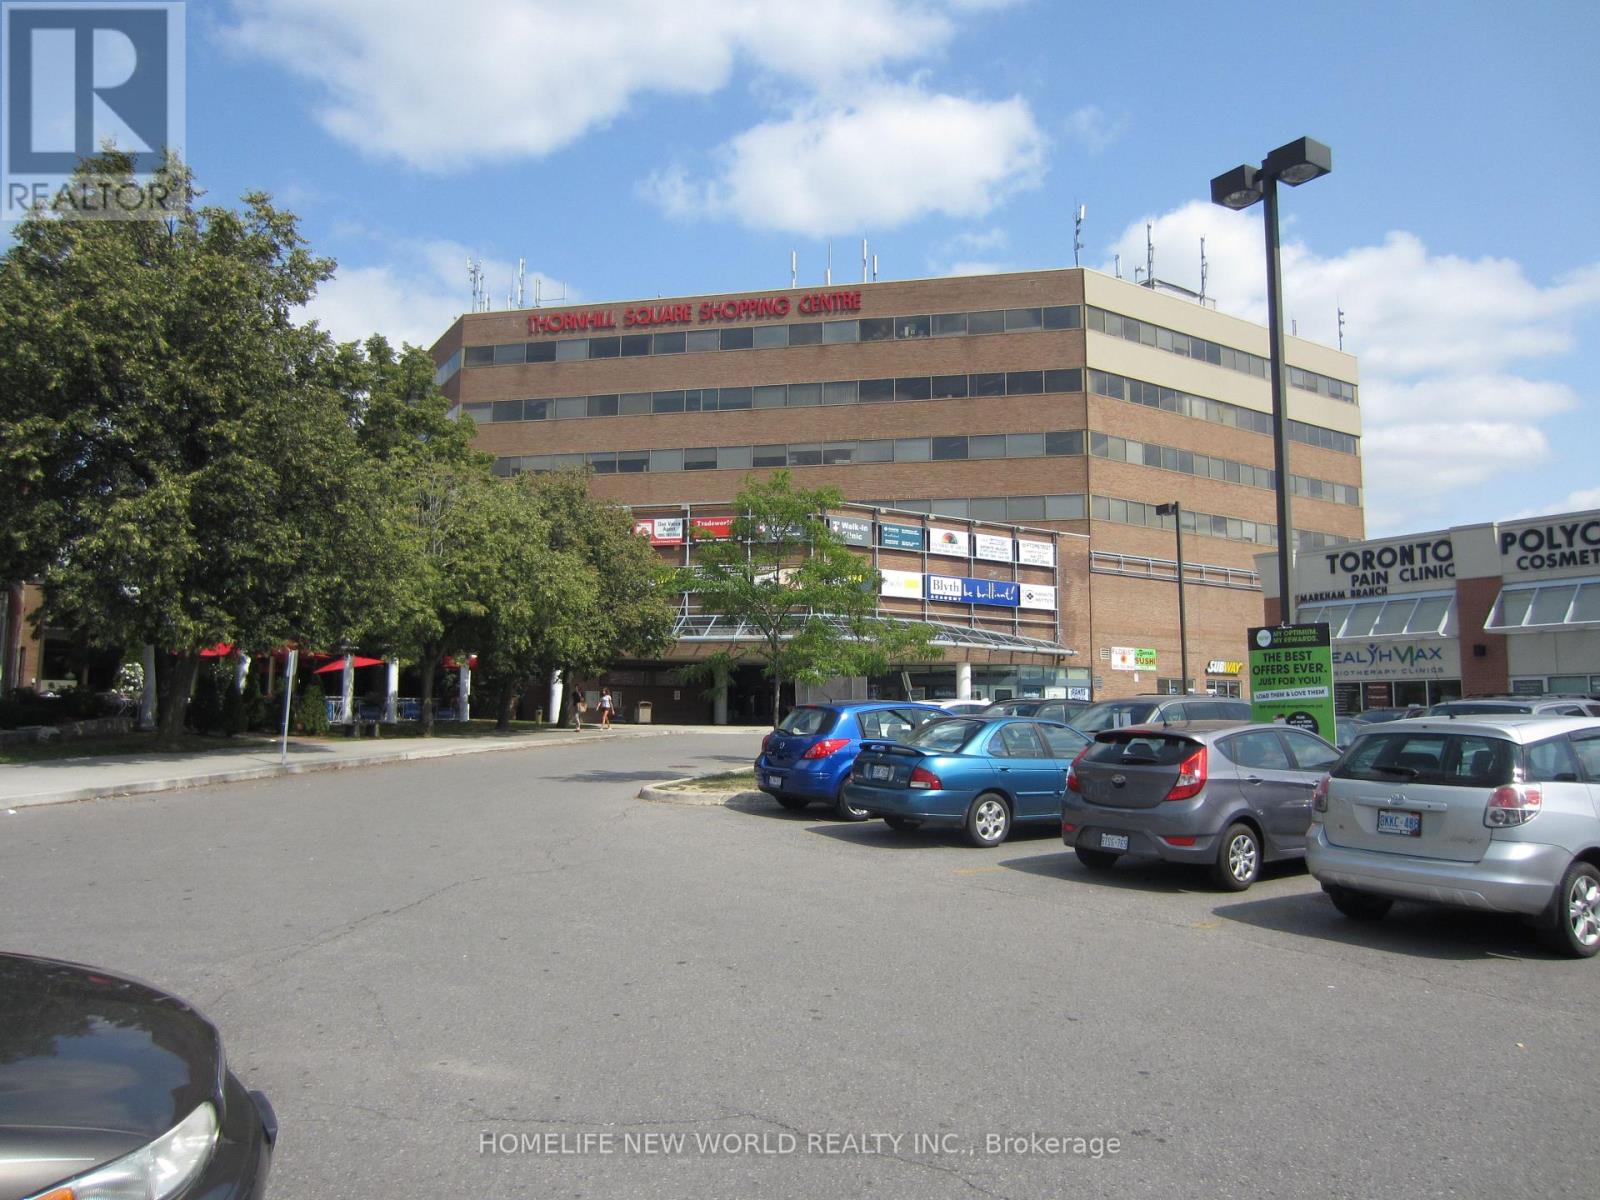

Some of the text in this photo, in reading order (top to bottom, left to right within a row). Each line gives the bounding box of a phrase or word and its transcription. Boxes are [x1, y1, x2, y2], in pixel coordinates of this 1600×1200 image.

[527, 290, 862, 335] THORNHILL SQUARE SHOPPING CENTRE
[1325, 539, 1454, 574] TORONTO
[1516, 548, 1600, 570] COSMET
[1351, 563, 1456, 587] PAIN CLINIC
[932, 579, 960, 595] Blyth
[963, 580, 1016, 601] be brilliant!
[1300, 586, 1388, 604] MARKHAM BRANCH
[1135, 657, 1156, 665] SUSHI
[1262, 650, 1313, 663] THE BEST
[1332, 644, 1442, 667] EALTHMAX
[1207, 660, 1243, 674] SUBWAY
[1252, 663, 1328, 675] OFFERS EVER.
[1401, 666, 1444, 675] CLINICS
[1258, 676, 1322, 686] JUST FOR YOU!
